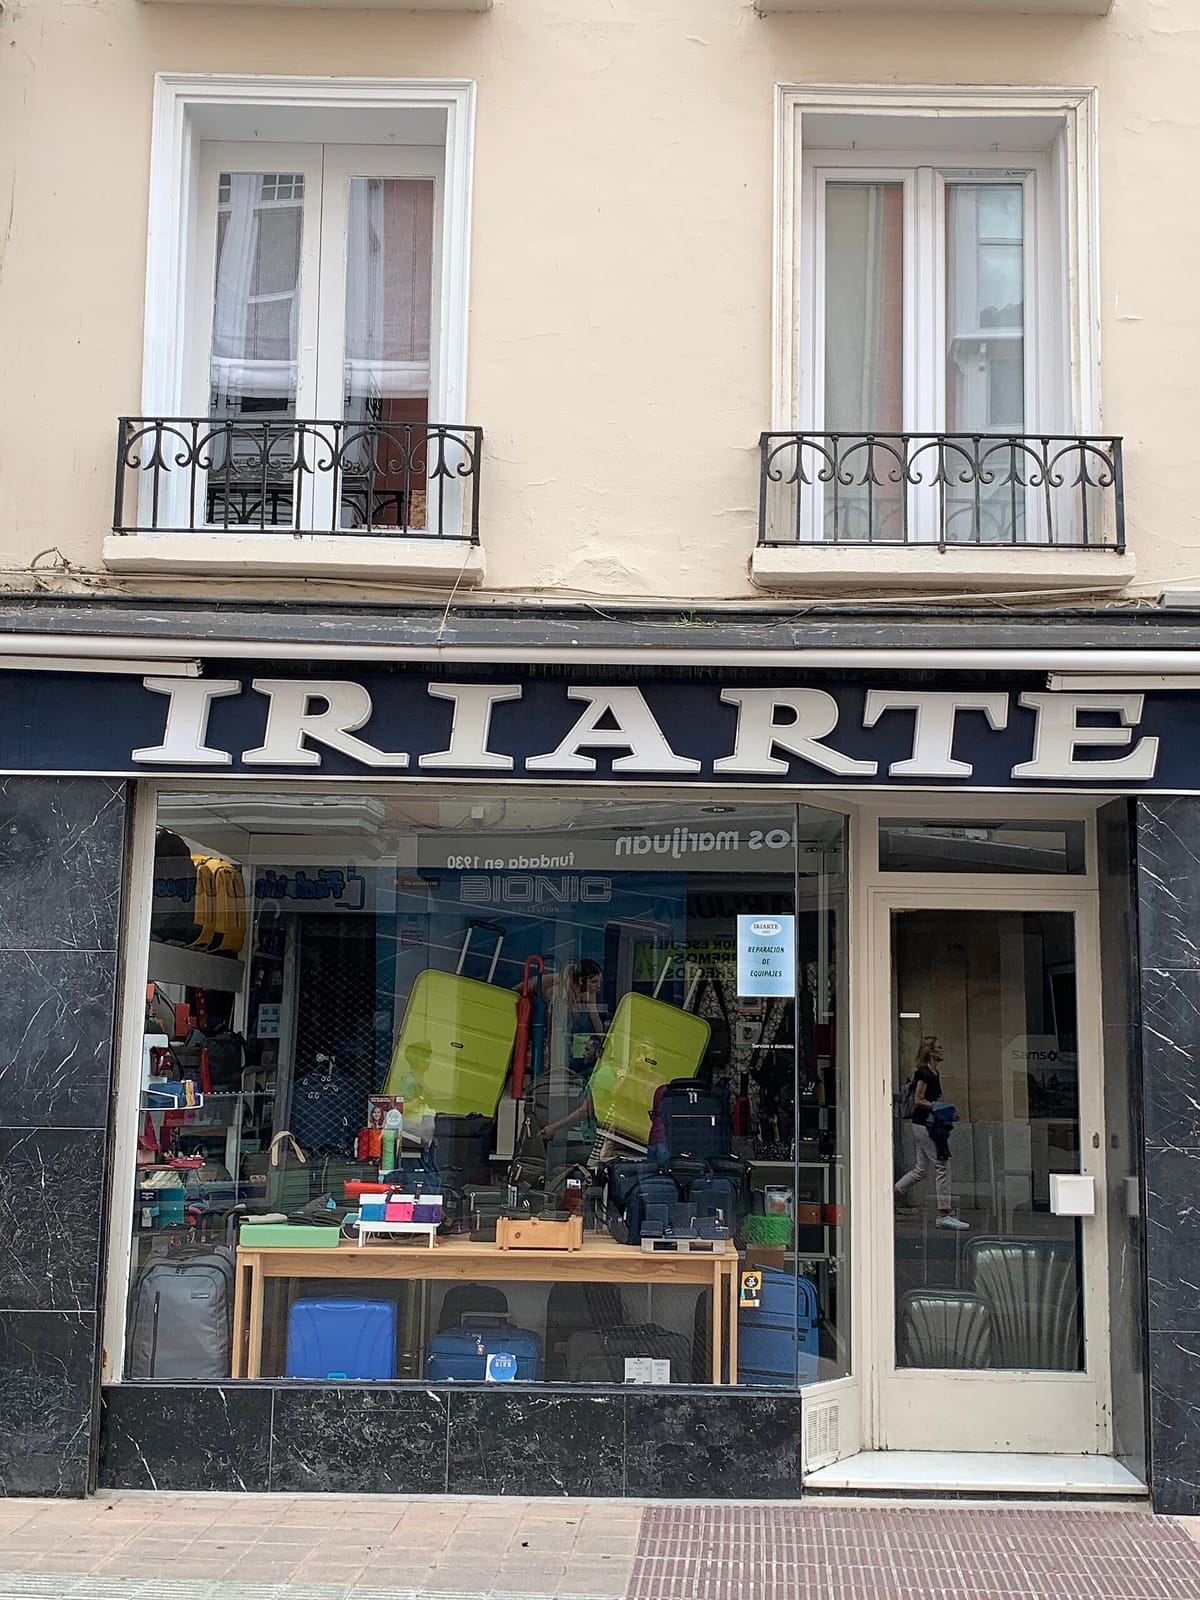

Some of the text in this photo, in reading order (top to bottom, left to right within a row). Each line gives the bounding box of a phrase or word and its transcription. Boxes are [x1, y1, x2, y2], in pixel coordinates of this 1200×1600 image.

[131, 677, 1160, 781] IRIARTE
[460, 875, 613, 903] BIONIC
[761, 958, 771, 966] DE
[750, 970, 783, 978] EQUIPAJES
